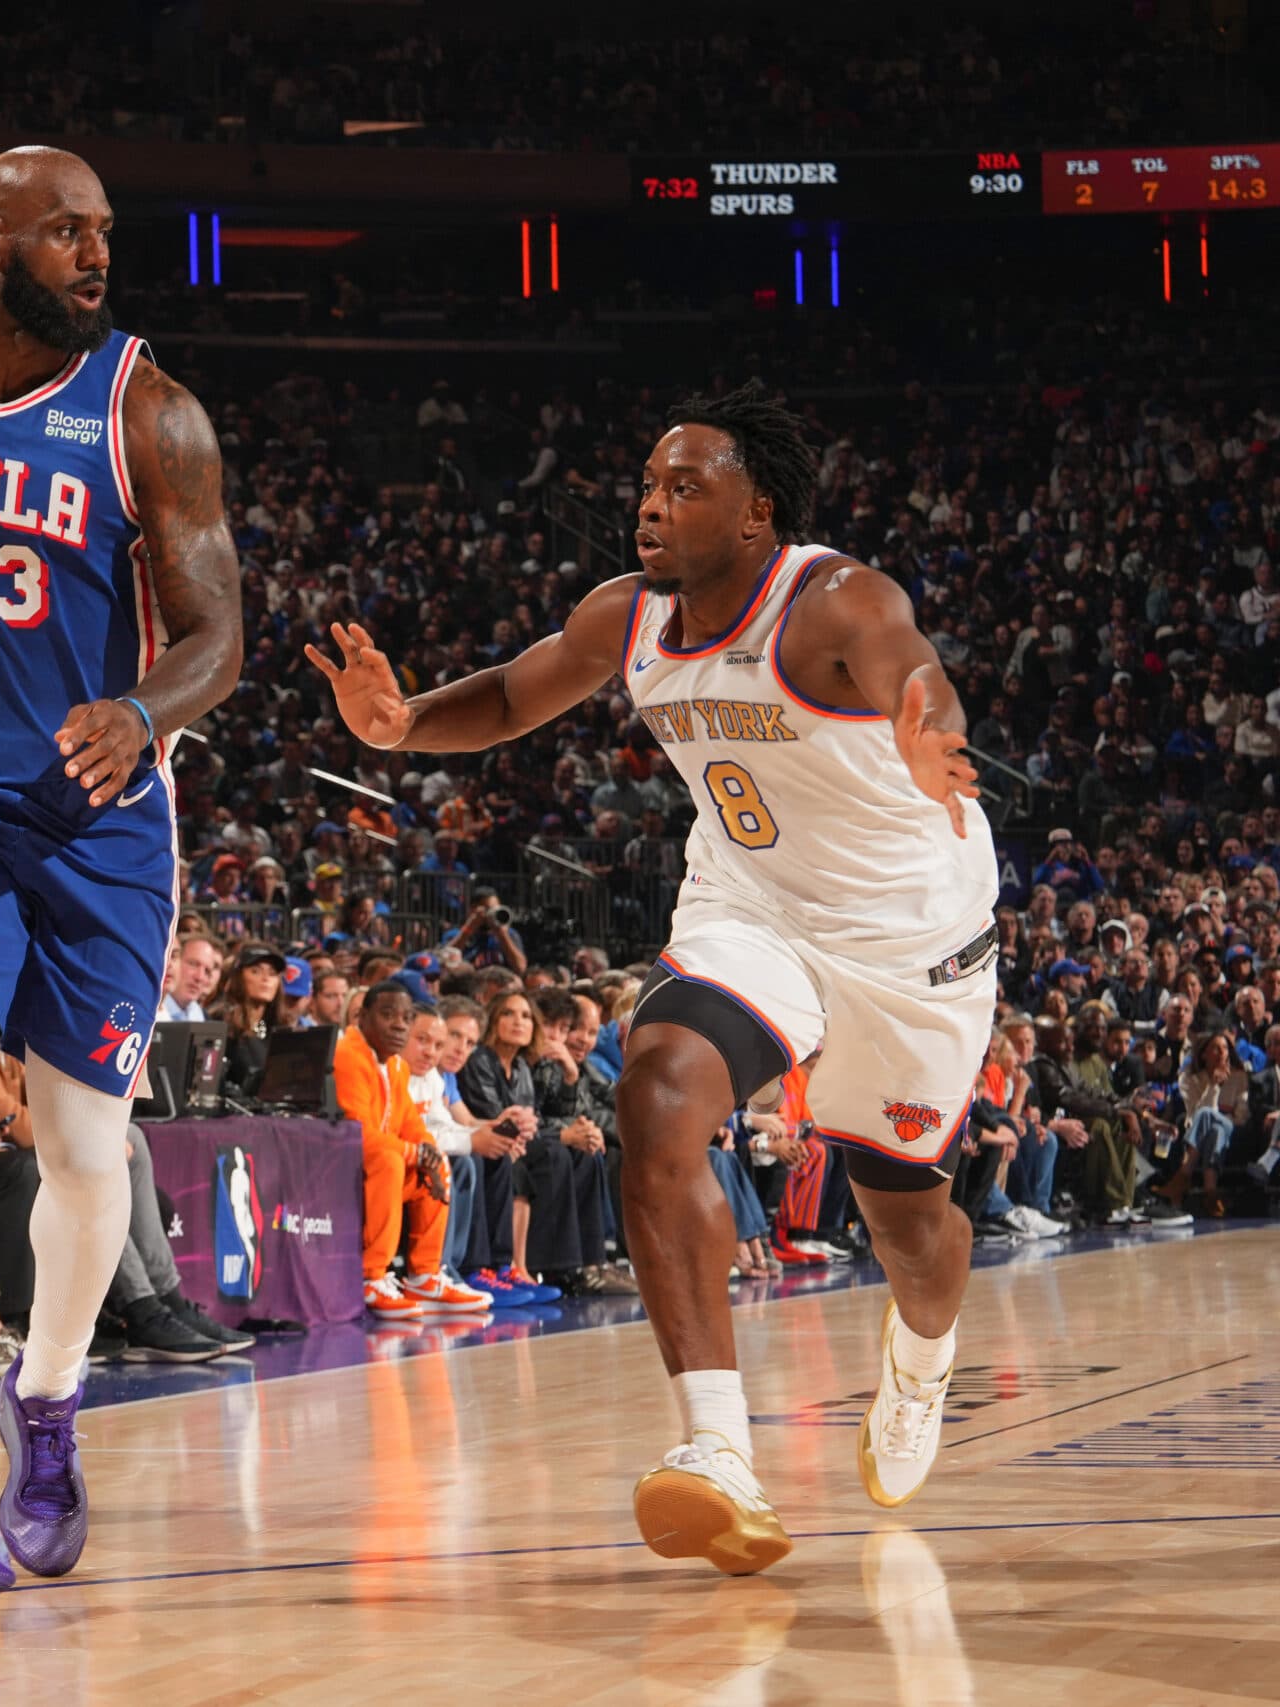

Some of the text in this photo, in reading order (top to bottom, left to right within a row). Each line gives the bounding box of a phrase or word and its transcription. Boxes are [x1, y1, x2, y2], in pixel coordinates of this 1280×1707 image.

[977, 153, 1021, 170] NBA
[1066, 154, 1261, 176] FLS TOL 3PT%
[710, 163, 838, 185] THUNDER
[969, 174, 1023, 194] 9:30
[643, 177, 699, 199] 7:32
[1075, 178, 1268, 206] 2 7 14.3
[710, 194, 795, 216] SPURS
[46, 409, 103, 431] Bloom
[44, 424, 101, 445] energy
[639, 699, 800, 744] NEW YORK
[703, 760, 780, 851] 8
[87, 1019, 142, 1076] 76
[882, 1102, 941, 1129] KNICKS
